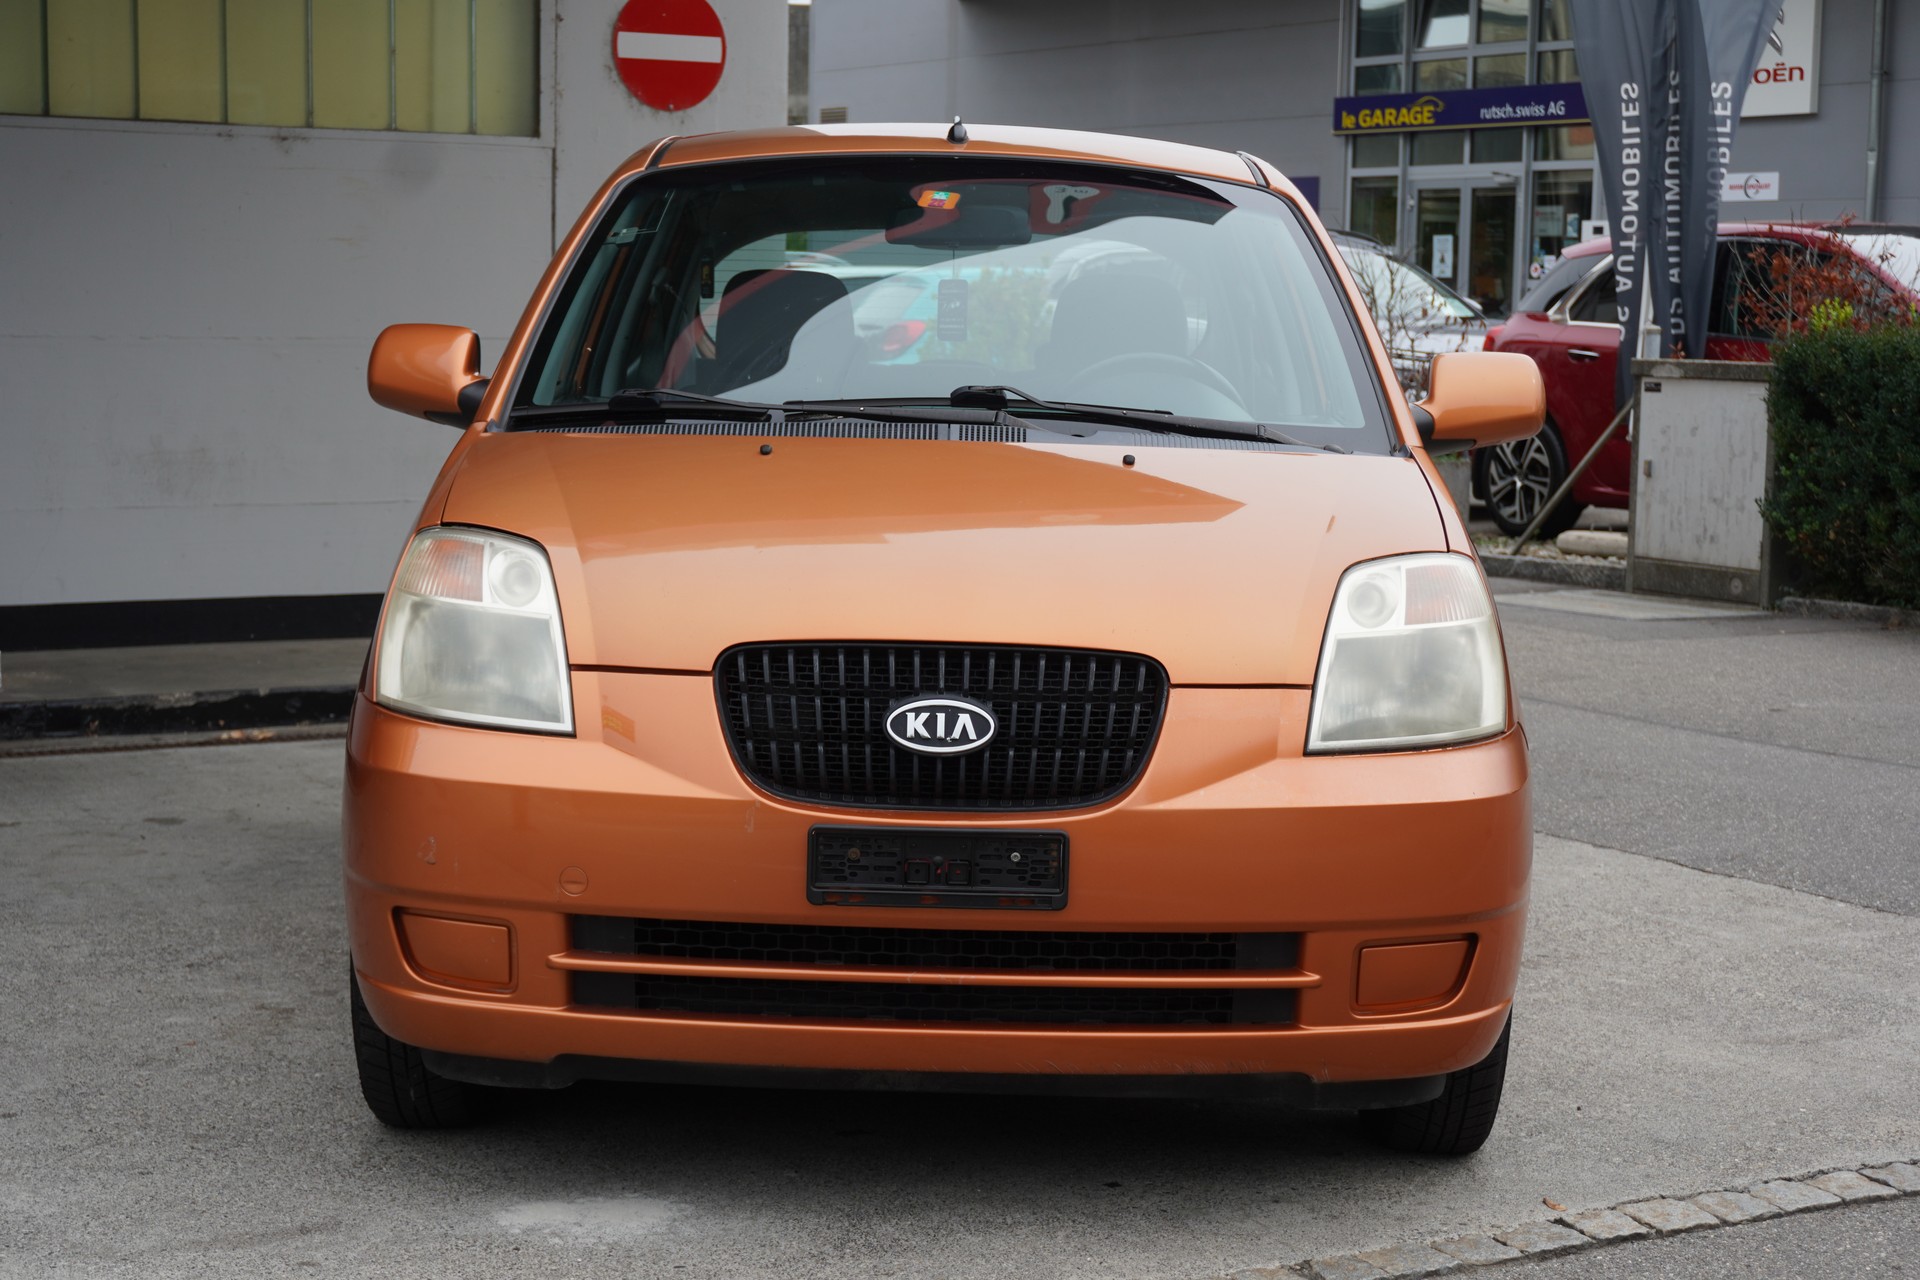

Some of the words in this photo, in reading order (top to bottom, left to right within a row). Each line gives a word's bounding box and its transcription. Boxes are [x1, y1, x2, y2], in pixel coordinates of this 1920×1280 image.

[1341, 110, 1357, 128] le
[1358, 105, 1436, 127] GARAGE
[1480, 101, 1546, 120] rutsch.swiss
[1547, 100, 1566, 116] AG
[906, 712, 977, 741] KIA
